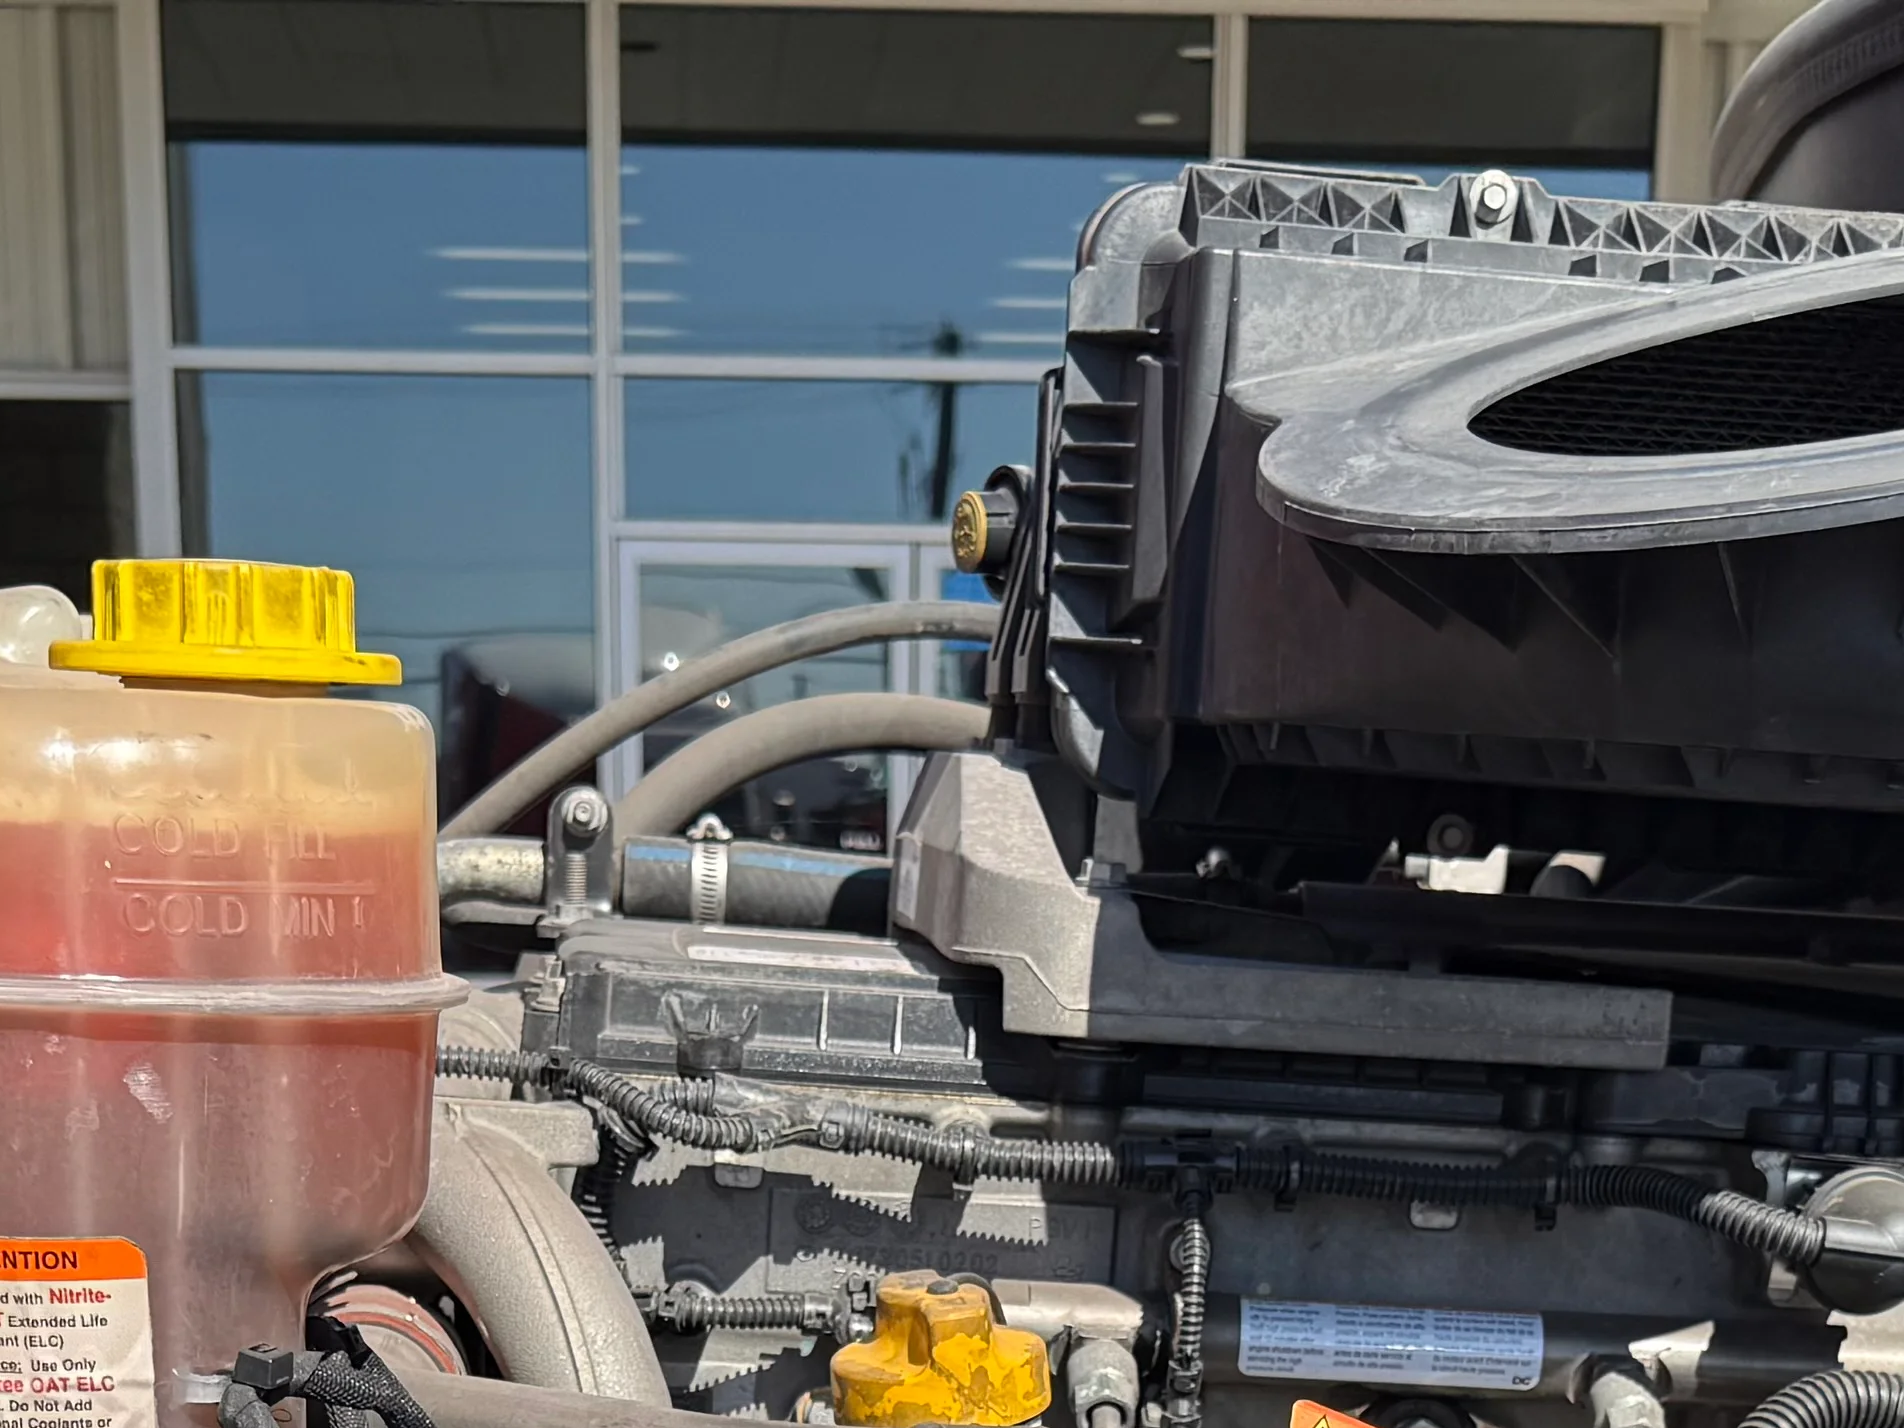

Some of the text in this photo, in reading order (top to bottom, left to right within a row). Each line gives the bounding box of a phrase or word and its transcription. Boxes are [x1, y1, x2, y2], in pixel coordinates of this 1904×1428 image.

[114, 812, 242, 860] COLD
[122, 892, 249, 938] COLD
[12, 1291, 44, 1305] with
[49, 1288, 112, 1305] Nitrite-
[8, 1314, 76, 1329] Extended
[80, 1315, 108, 1328] Life
[23, 1334, 65, 1350] (ELC)
[30, 1358, 58, 1373] Use
[62, 1358, 97, 1375] Only
[30, 1376, 69, 1395] OAT
[76, 1375, 115, 1393] ELC
[1512, 1376, 1532, 1387] DC
[9, 1398, 30, 1413] Do
[33, 1399, 60, 1413] Not
[63, 1399, 93, 1412] Add
[97, 1417, 113, 1428] or
